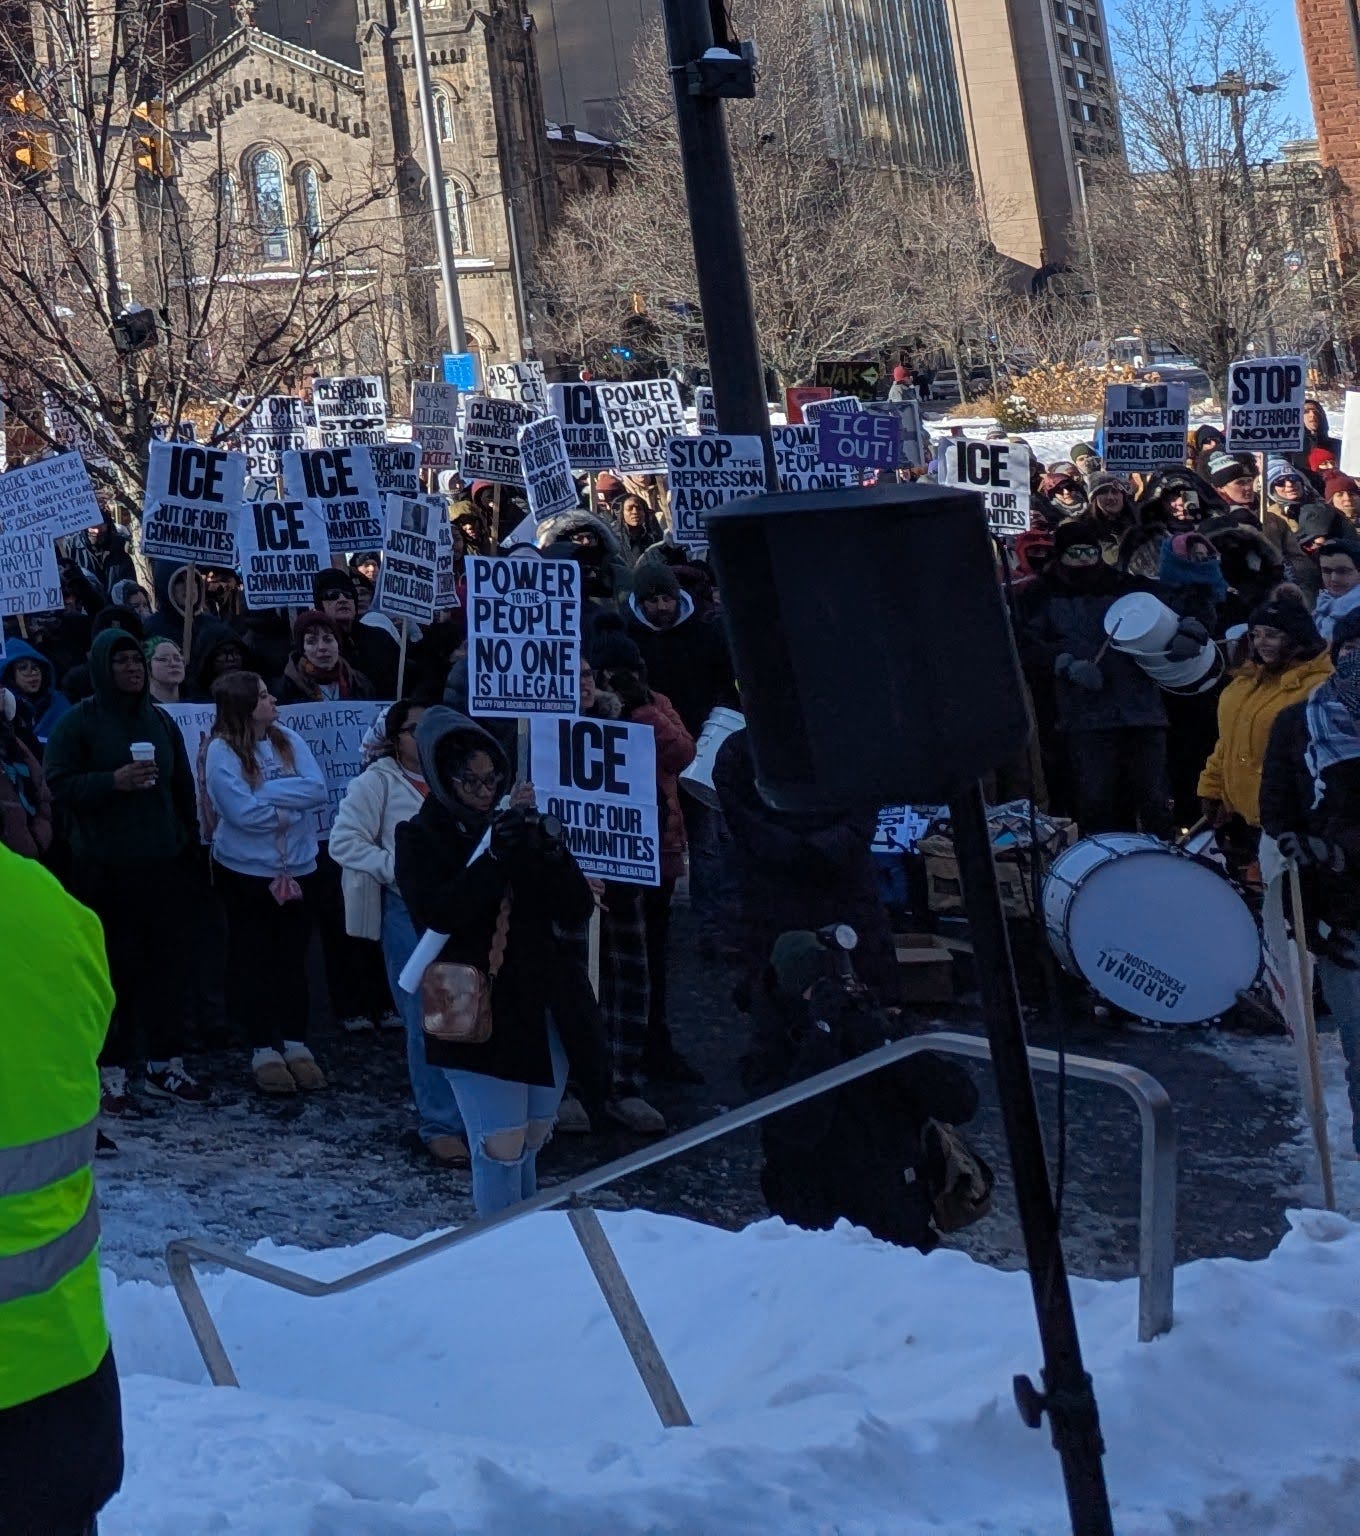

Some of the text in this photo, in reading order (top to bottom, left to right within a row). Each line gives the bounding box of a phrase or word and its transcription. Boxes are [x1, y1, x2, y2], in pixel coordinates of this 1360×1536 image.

[318, 382, 377, 400] CLEVELAND
[602, 381, 674, 406] POWER
[1232, 365, 1302, 405] STOP
[268, 398, 301, 413] ONE
[318, 402, 382, 417] MINNEAPOLIS
[471, 403, 538, 424] CLEVELAND
[606, 403, 680, 428] PEOPLE
[320, 419, 384, 430] STOP
[830, 415, 891, 439] ICE
[1108, 409, 1185, 427] JUSTICE FOR
[1232, 408, 1300, 427] ICE TERROR
[245, 435, 305, 454] POWER
[341, 430, 386, 446] TERROR
[613, 430, 640, 450] NO
[1107, 432, 1184, 443] RENEE
[1230, 428, 1300, 440] NOW!
[534, 442, 565, 468] GUILTY
[618, 450, 630, 463] IS
[669, 439, 732, 468] STOP
[838, 438, 893, 462] OUT!
[1107, 444, 1184, 460] NICOLE GOOD
[48, 463, 65, 476] NOT
[465, 454, 484, 469] ICE
[730, 458, 762, 468] THE
[956, 441, 1011, 487] ICE
[168, 446, 227, 503] ICE
[300, 449, 359, 498] ICE
[671, 470, 764, 487] REPRESSION
[807, 474, 847, 489] ONE
[31, 480, 59, 496] UNTIL
[535, 475, 572, 509] DOWN!
[343, 502, 370, 519] OUR
[991, 493, 1017, 508] OUR
[182, 507, 228, 530] OF OUR
[252, 502, 309, 551] ICE
[145, 521, 234, 551] COMMUNITIES
[386, 529, 437, 562] JUSTICE FOR
[1, 551, 43, 573] HAPPEN
[251, 554, 320, 573] OUT OF OUR
[384, 572, 416, 600] NICOLE
[474, 560, 575, 598] POWER
[523, 592, 540, 604] THE
[474, 599, 575, 637] PEOPLE
[475, 638, 575, 675] NO ONE
[475, 674, 575, 699] IS ILLEGAL!
[558, 718, 630, 795] ICE
[547, 797, 642, 834] OUT OF OUR
[1097, 950, 1179, 1008] CARDINAL
[1124, 953, 1186, 995] PERCUSSION
